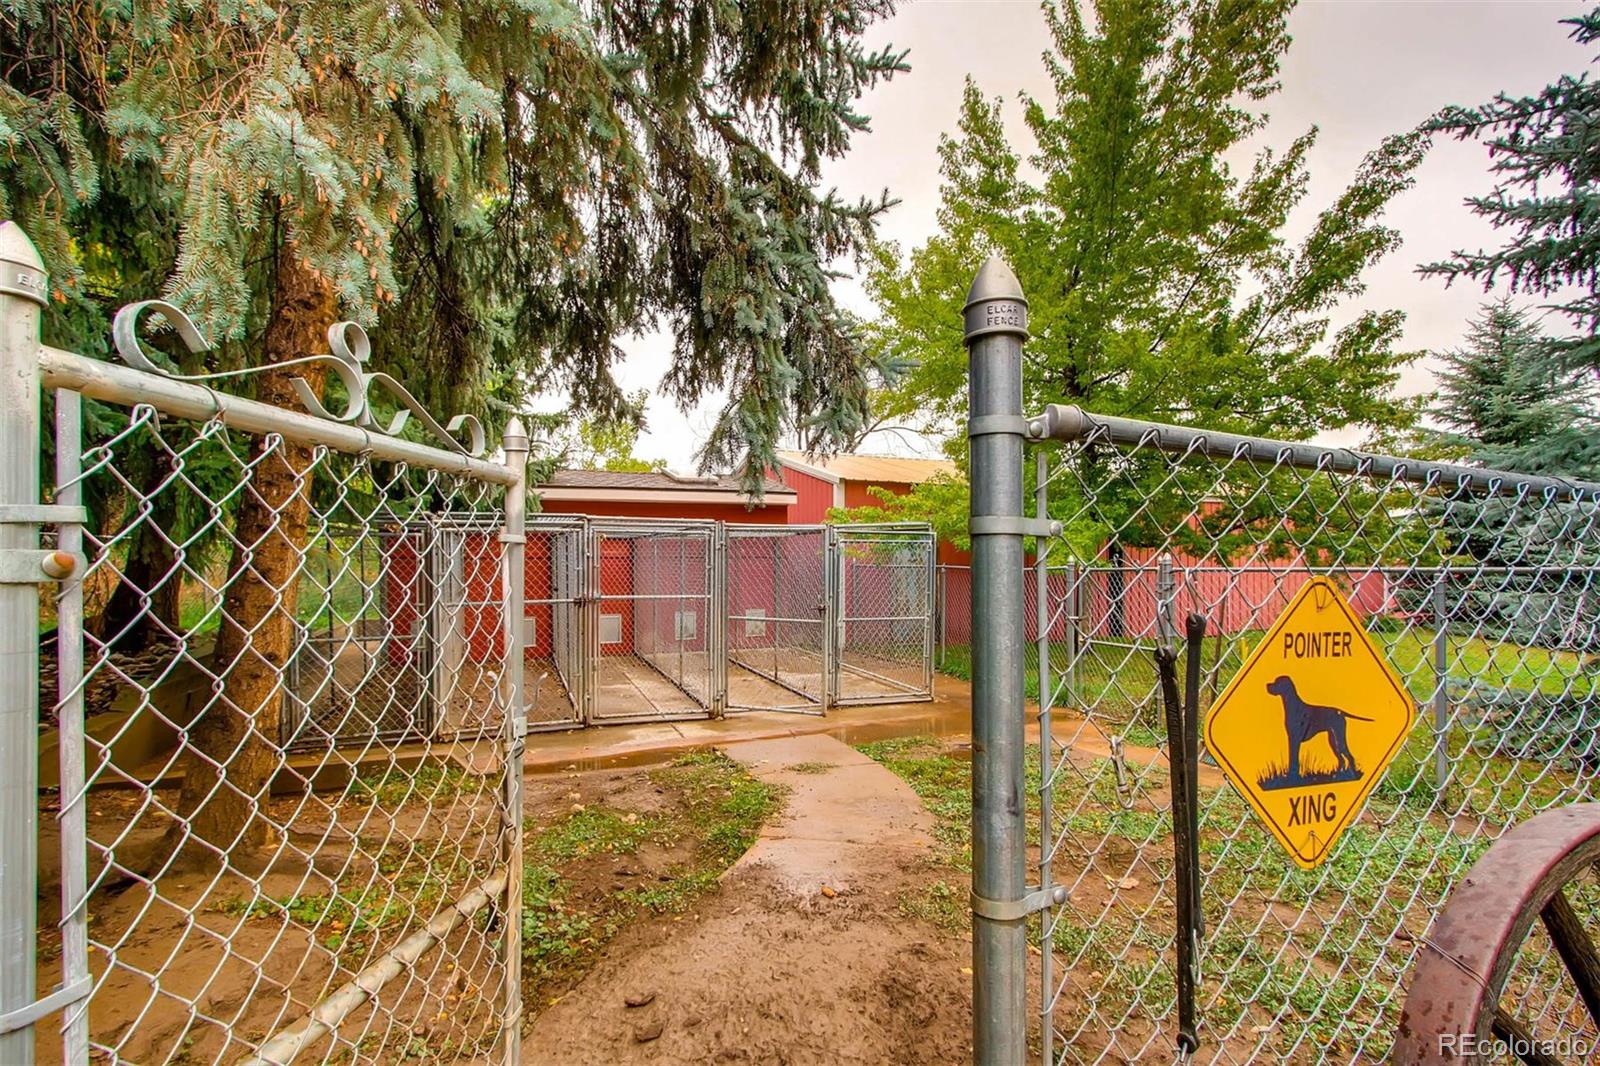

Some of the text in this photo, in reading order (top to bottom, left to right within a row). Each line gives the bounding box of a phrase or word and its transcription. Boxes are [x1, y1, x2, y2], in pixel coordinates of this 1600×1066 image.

[987, 316, 1019, 326] FENCE
[1284, 631, 1352, 658] POINTER
[1288, 791, 1337, 827] XING
